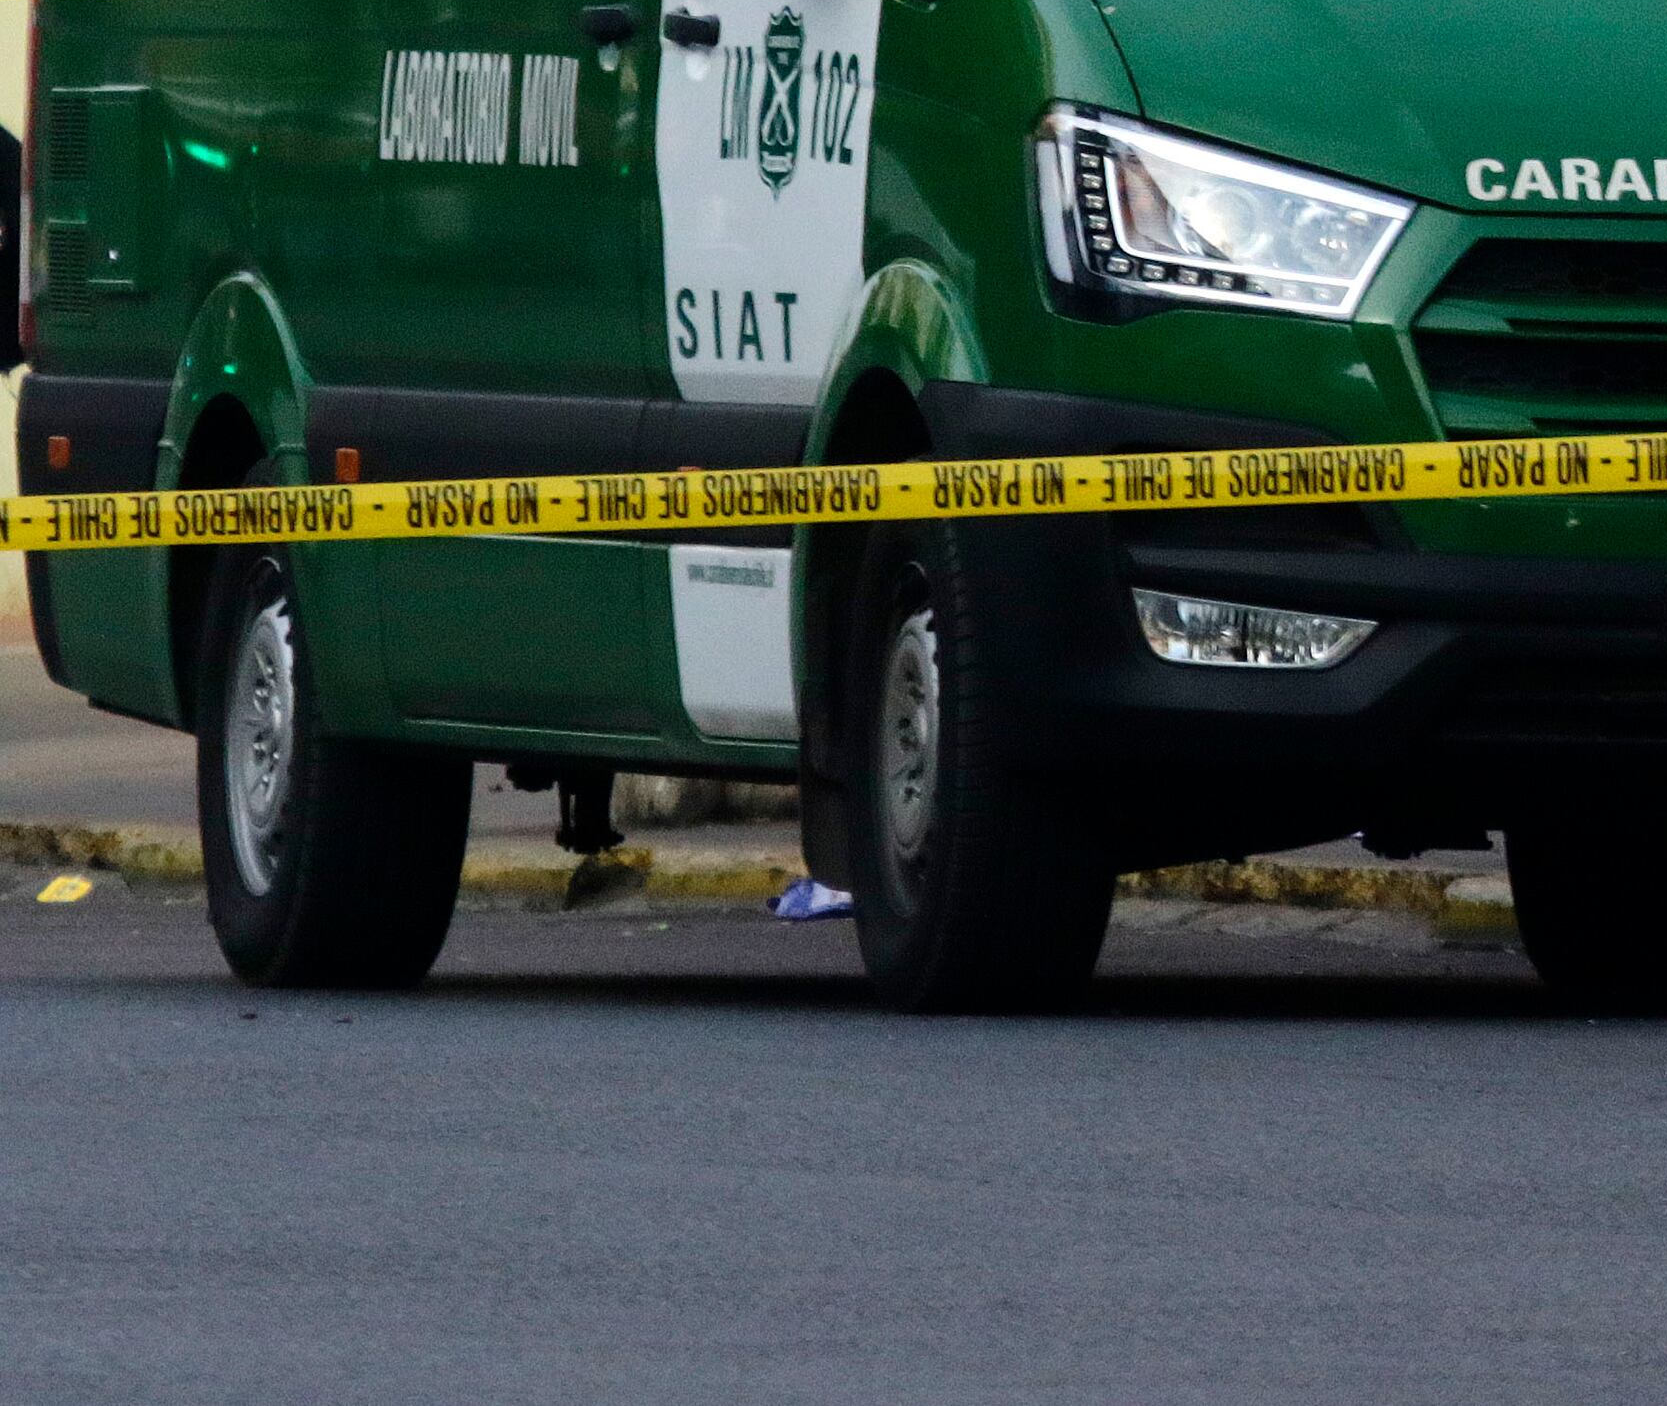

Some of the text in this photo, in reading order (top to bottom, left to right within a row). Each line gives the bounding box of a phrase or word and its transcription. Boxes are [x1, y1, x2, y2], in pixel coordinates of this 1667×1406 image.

[380, 49, 580, 167] LABORATORIO MOVIL
[811, 50, 860, 165] 102
[676, 287, 798, 362] SIAT
[1033, 461, 1065, 505] NO
[1102, 457, 1170, 502] CHILE
[1184, 456, 1215, 498] DE
[1229, 448, 1404, 497] CARABINEROS
[1458, 444, 1544, 488] PASAR
[1556, 441, 1588, 485] NO
[407, 483, 494, 528] PASAR
[507, 481, 539, 525] NO
[576, 477, 645, 522] CHILE
[658, 476, 688, 518] DE
[704, 467, 879, 517] CARABINEROS
[934, 464, 1020, 508] PASAR
[47, 496, 117, 541] CHILE
[130, 495, 160, 538] DE
[175, 488, 353, 536] CARABINEROS
